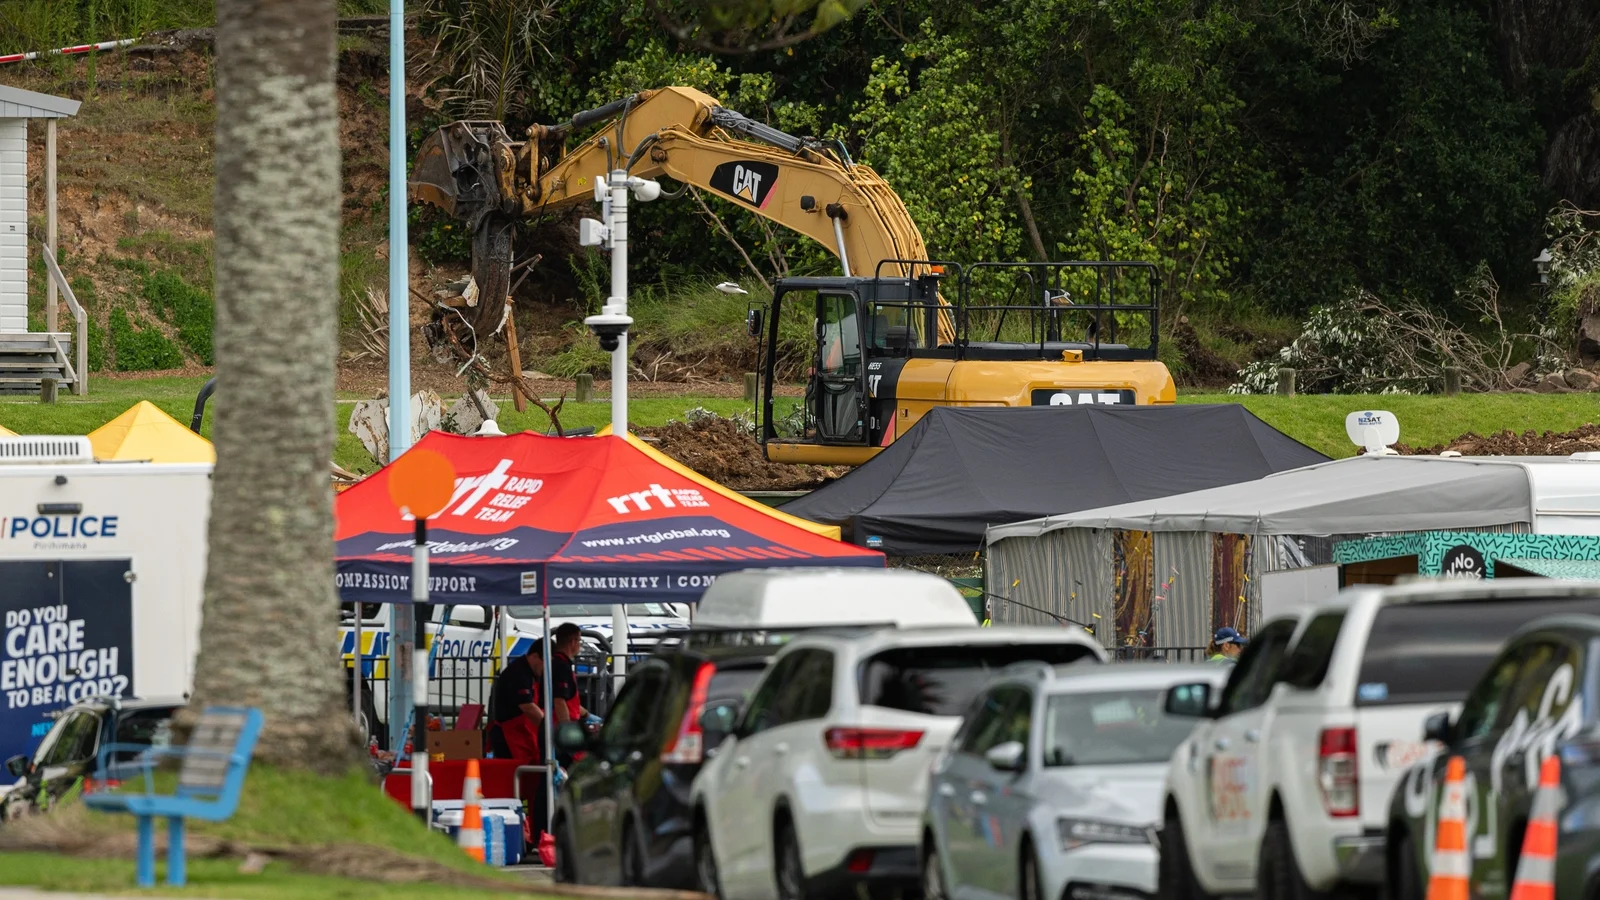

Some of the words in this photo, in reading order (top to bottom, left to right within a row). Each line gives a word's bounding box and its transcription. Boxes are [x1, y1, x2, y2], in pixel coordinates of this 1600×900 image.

[732, 164, 762, 203] CAT
[503, 476, 543, 494] RAPID
[489, 492, 532, 509] RELIEF
[606, 483, 676, 514] rrt
[474, 506, 511, 523] TEAM
[10, 516, 119, 538] POLICE
[582, 528, 731, 548] www.rrtglobal.org
[1455, 552, 1475, 570] NO
[335, 573, 409, 590] OMPASSION
[427, 576, 477, 592] UPPORT
[552, 576, 660, 590] COMMUNITY
[5, 609, 31, 629] DO
[32, 604, 68, 624] YOU
[5, 619, 86, 658] CARE
[442, 639, 492, 663] POLICE
[1, 646, 119, 691] ENOUGH
[6, 689, 30, 709] TO
[31, 686, 53, 706] BE
[54, 684, 67, 703] A
